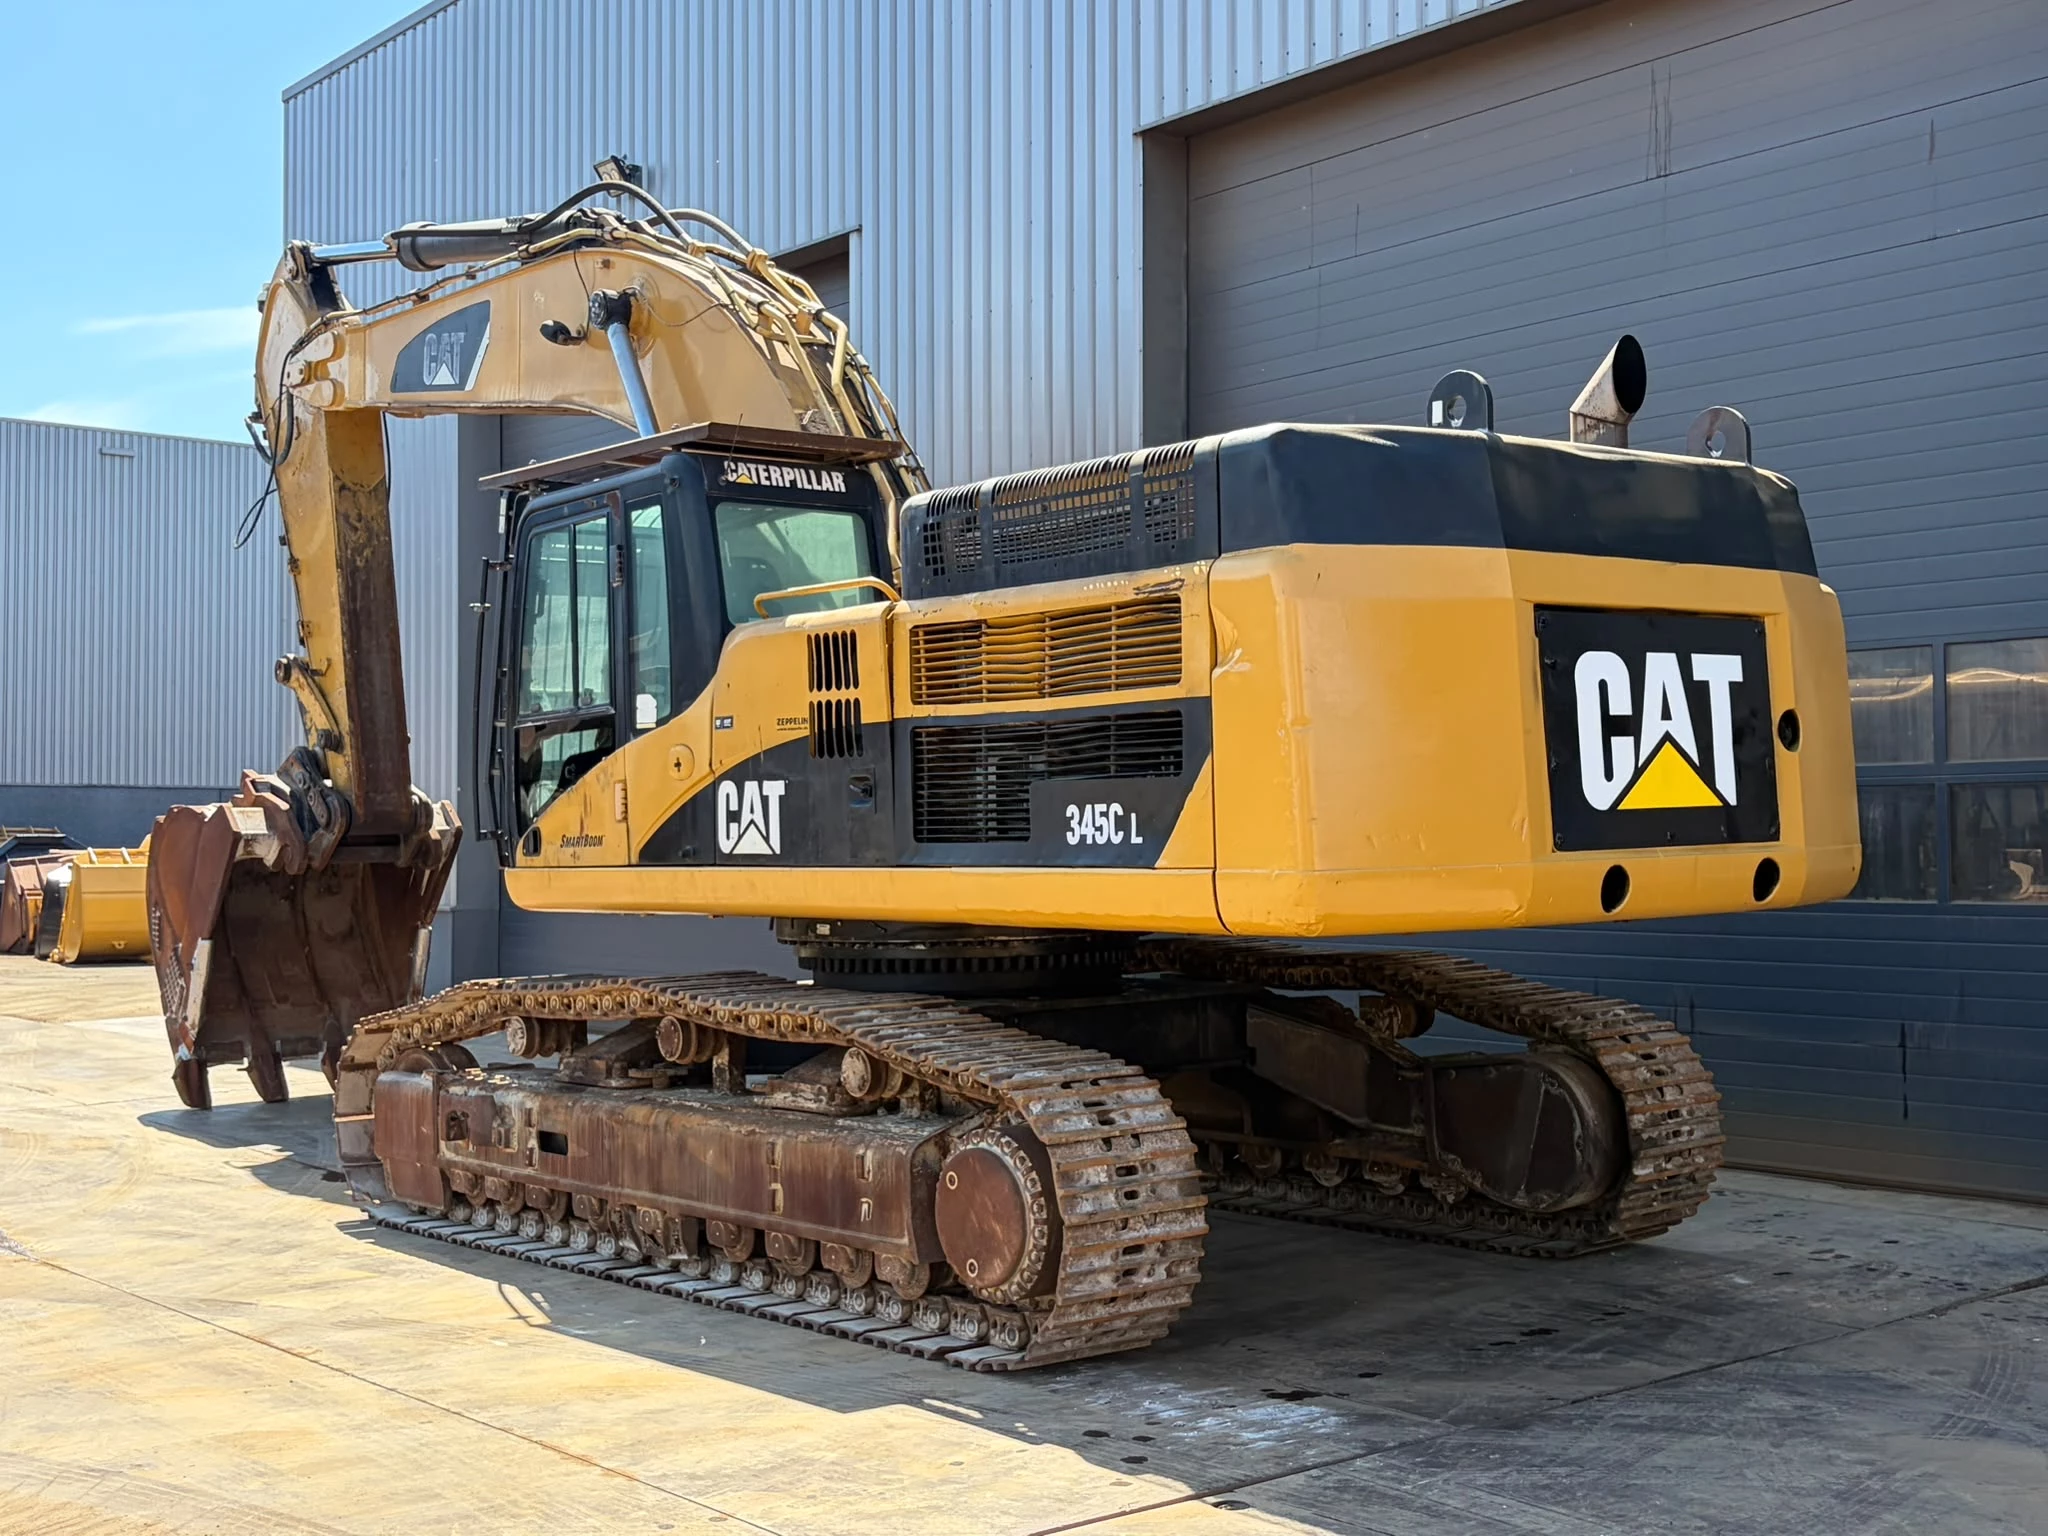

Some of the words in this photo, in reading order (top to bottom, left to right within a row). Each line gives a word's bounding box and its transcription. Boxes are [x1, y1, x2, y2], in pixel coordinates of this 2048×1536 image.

[423, 332, 466, 386] CAT
[724, 460, 847, 493] CATERPILLAR
[776, 717, 809, 726] ZEPPELIN
[1574, 650, 1744, 811] CAT
[718, 780, 786, 855] CAT
[1065, 802, 1124, 845] 345C
[1130, 812, 1143, 844] L
